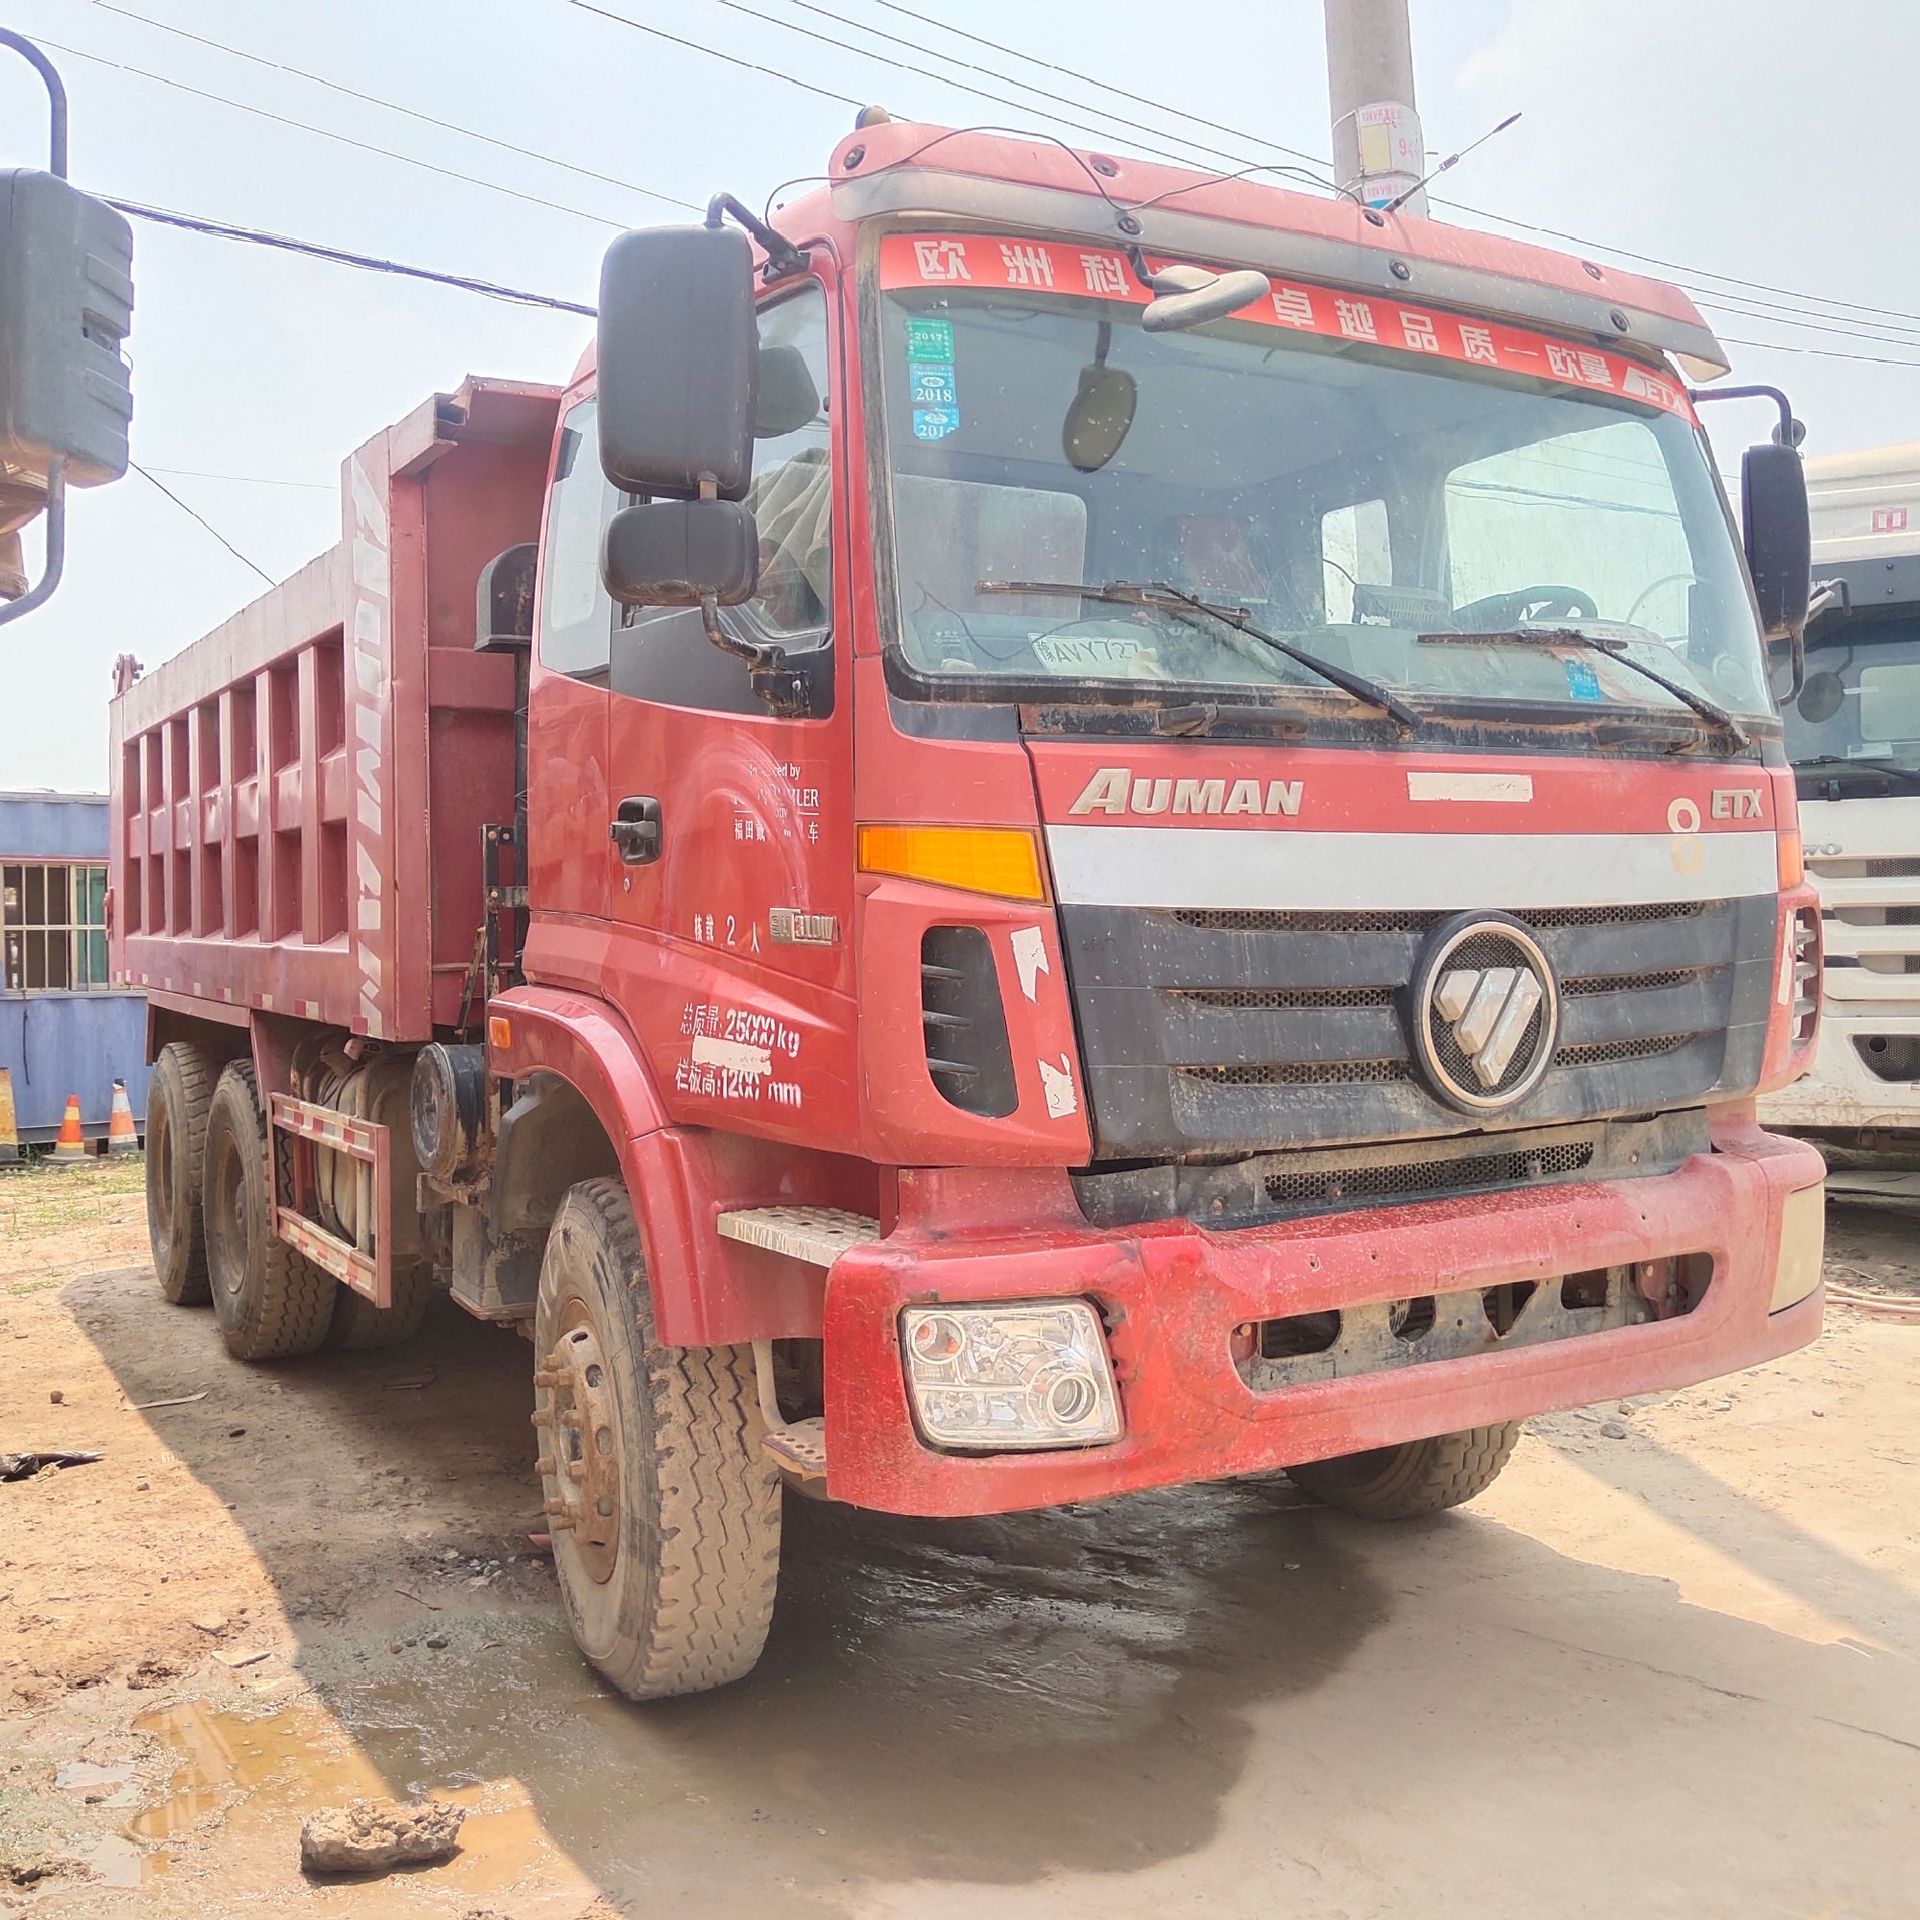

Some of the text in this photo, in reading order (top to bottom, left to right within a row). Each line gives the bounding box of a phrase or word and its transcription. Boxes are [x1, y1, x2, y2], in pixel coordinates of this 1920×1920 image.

[916, 387, 953, 402] 2018
[918, 424, 956, 437] 201
[1068, 768, 1304, 816] AUMAN
[1712, 789, 1763, 819] ETX
[727, 915, 736, 946] 2
